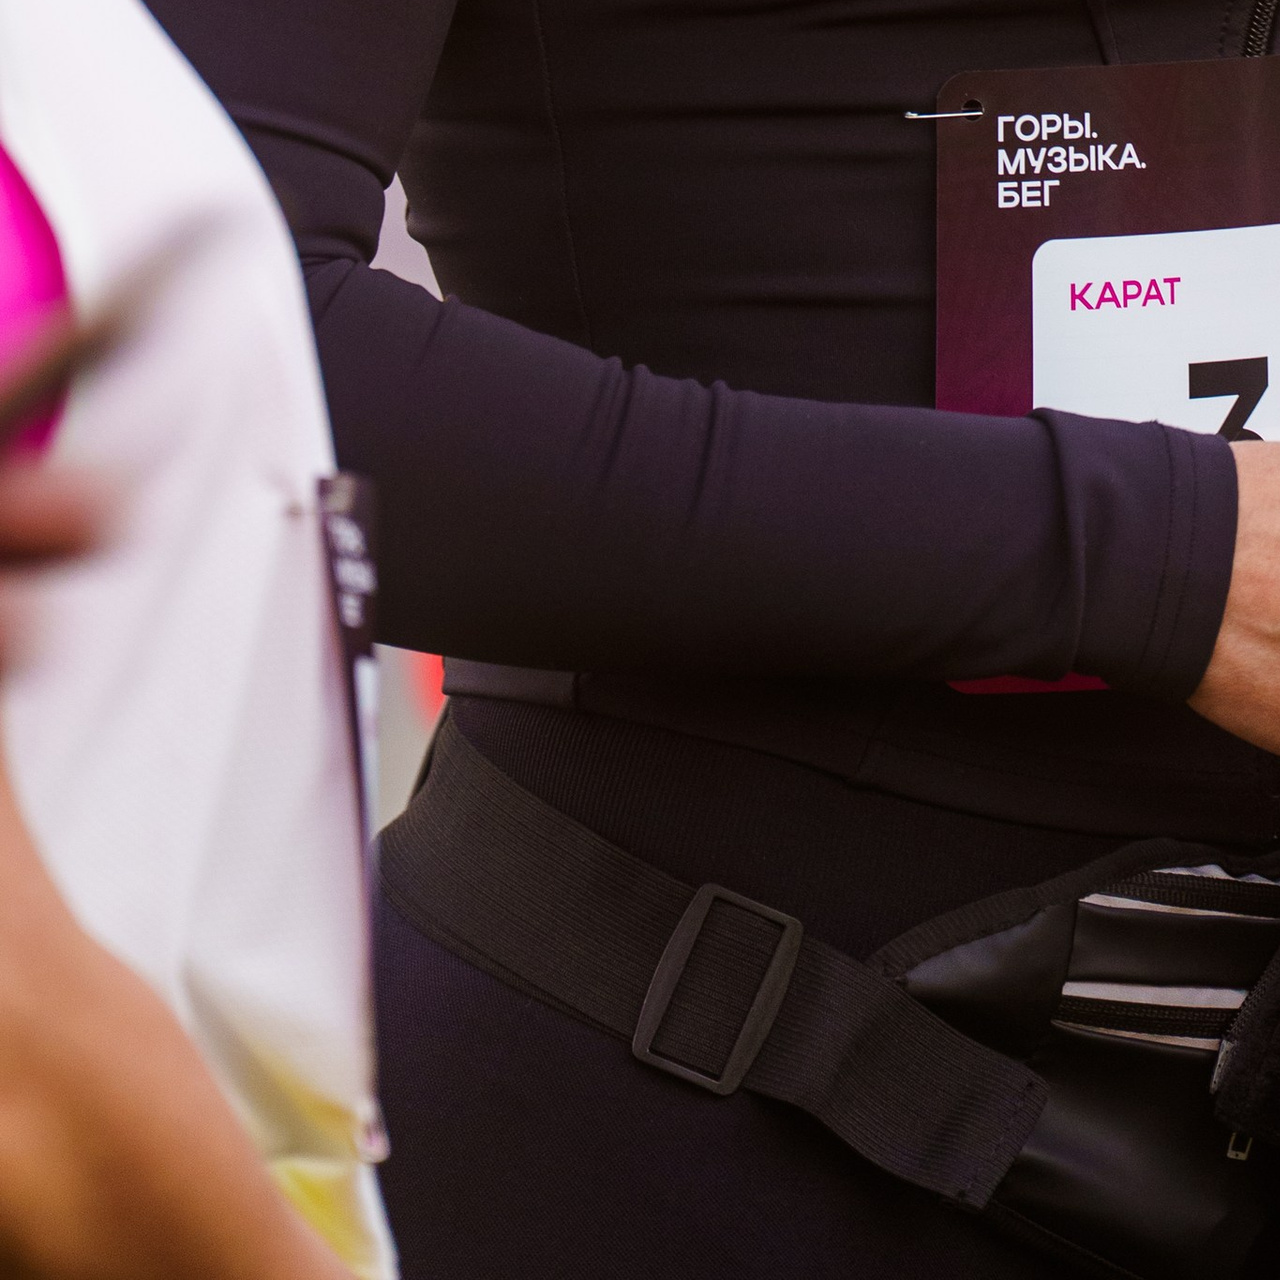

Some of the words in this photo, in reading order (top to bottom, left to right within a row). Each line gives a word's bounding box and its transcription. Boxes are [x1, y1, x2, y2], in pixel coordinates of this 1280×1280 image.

[997, 112, 1098, 143] ГОРЫ.
[997, 143, 1147, 176] МУЗЫКА.
[997, 179, 1060, 209] БЕГ
[1070, 276, 1181, 311] КАРАТ
